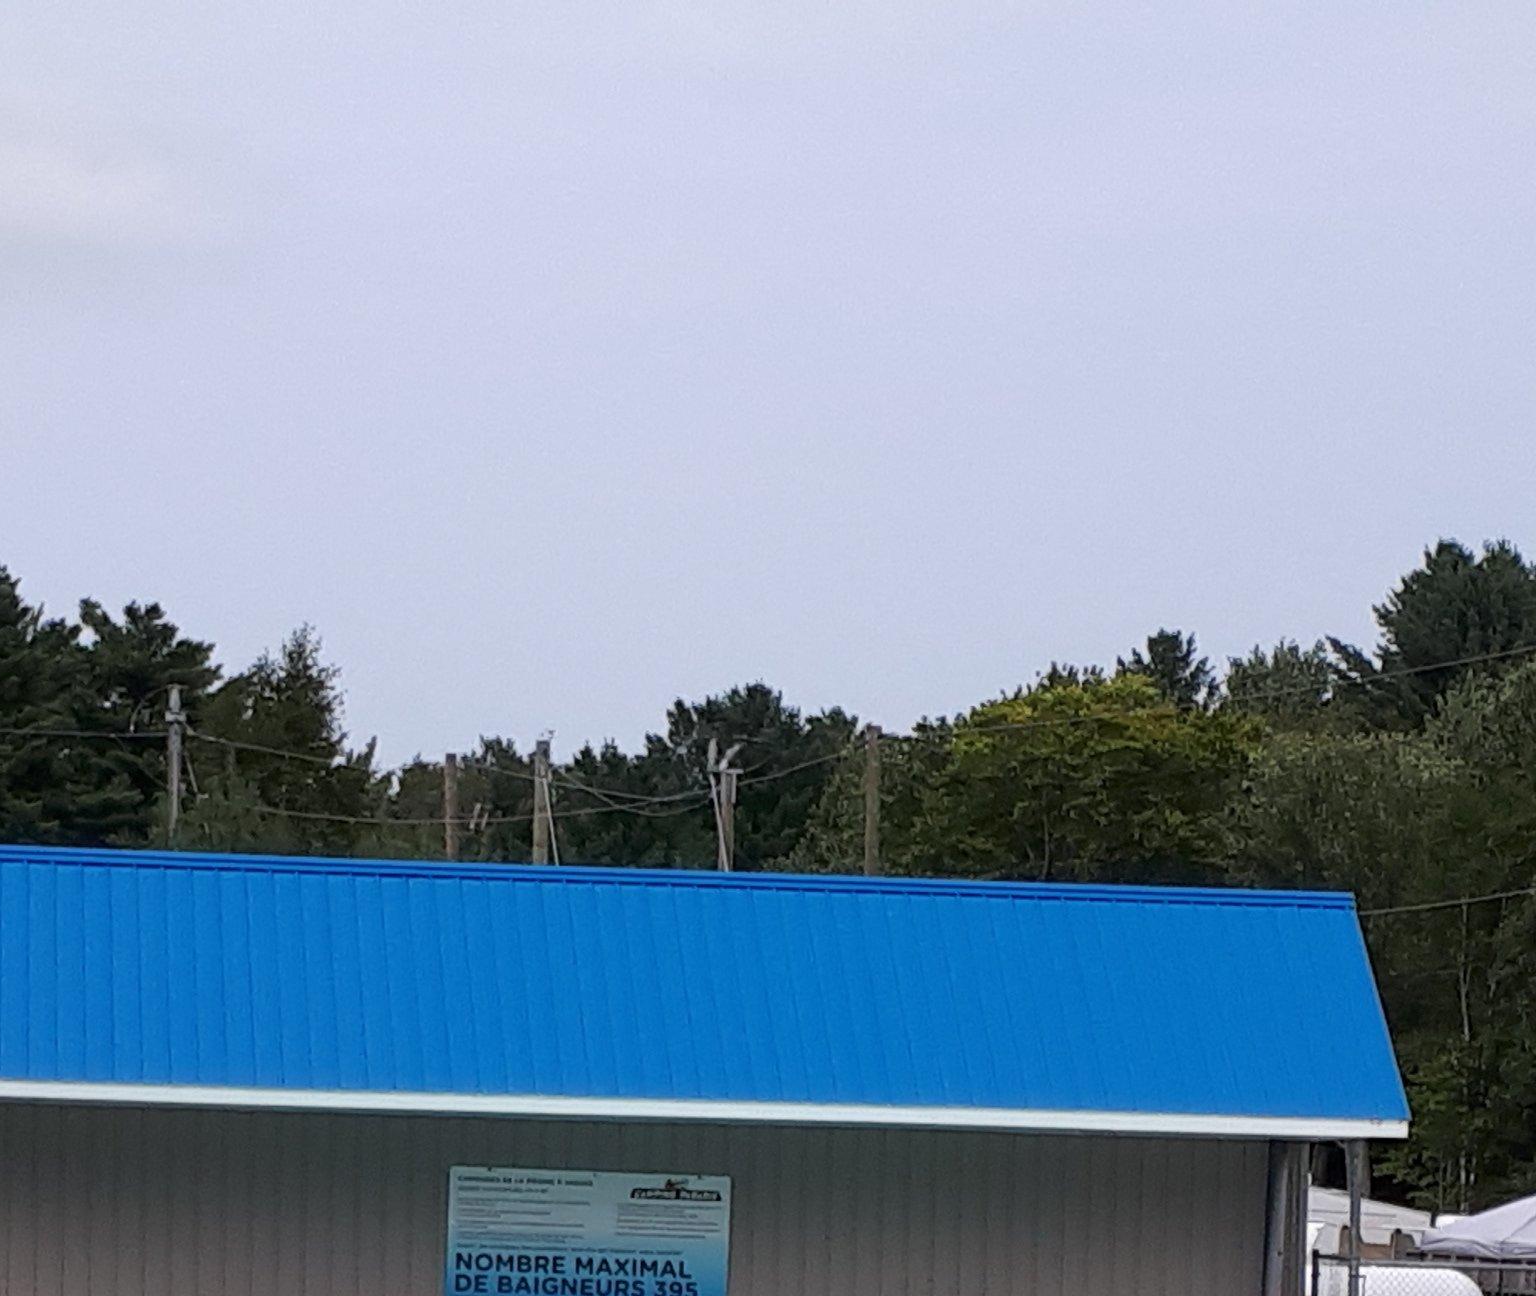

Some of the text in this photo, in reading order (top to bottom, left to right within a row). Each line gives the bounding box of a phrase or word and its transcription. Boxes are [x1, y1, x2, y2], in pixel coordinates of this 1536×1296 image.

[455, 1253, 692, 1279] NOMBRE MAXIMAL
[454, 1275, 488, 1293] DE
